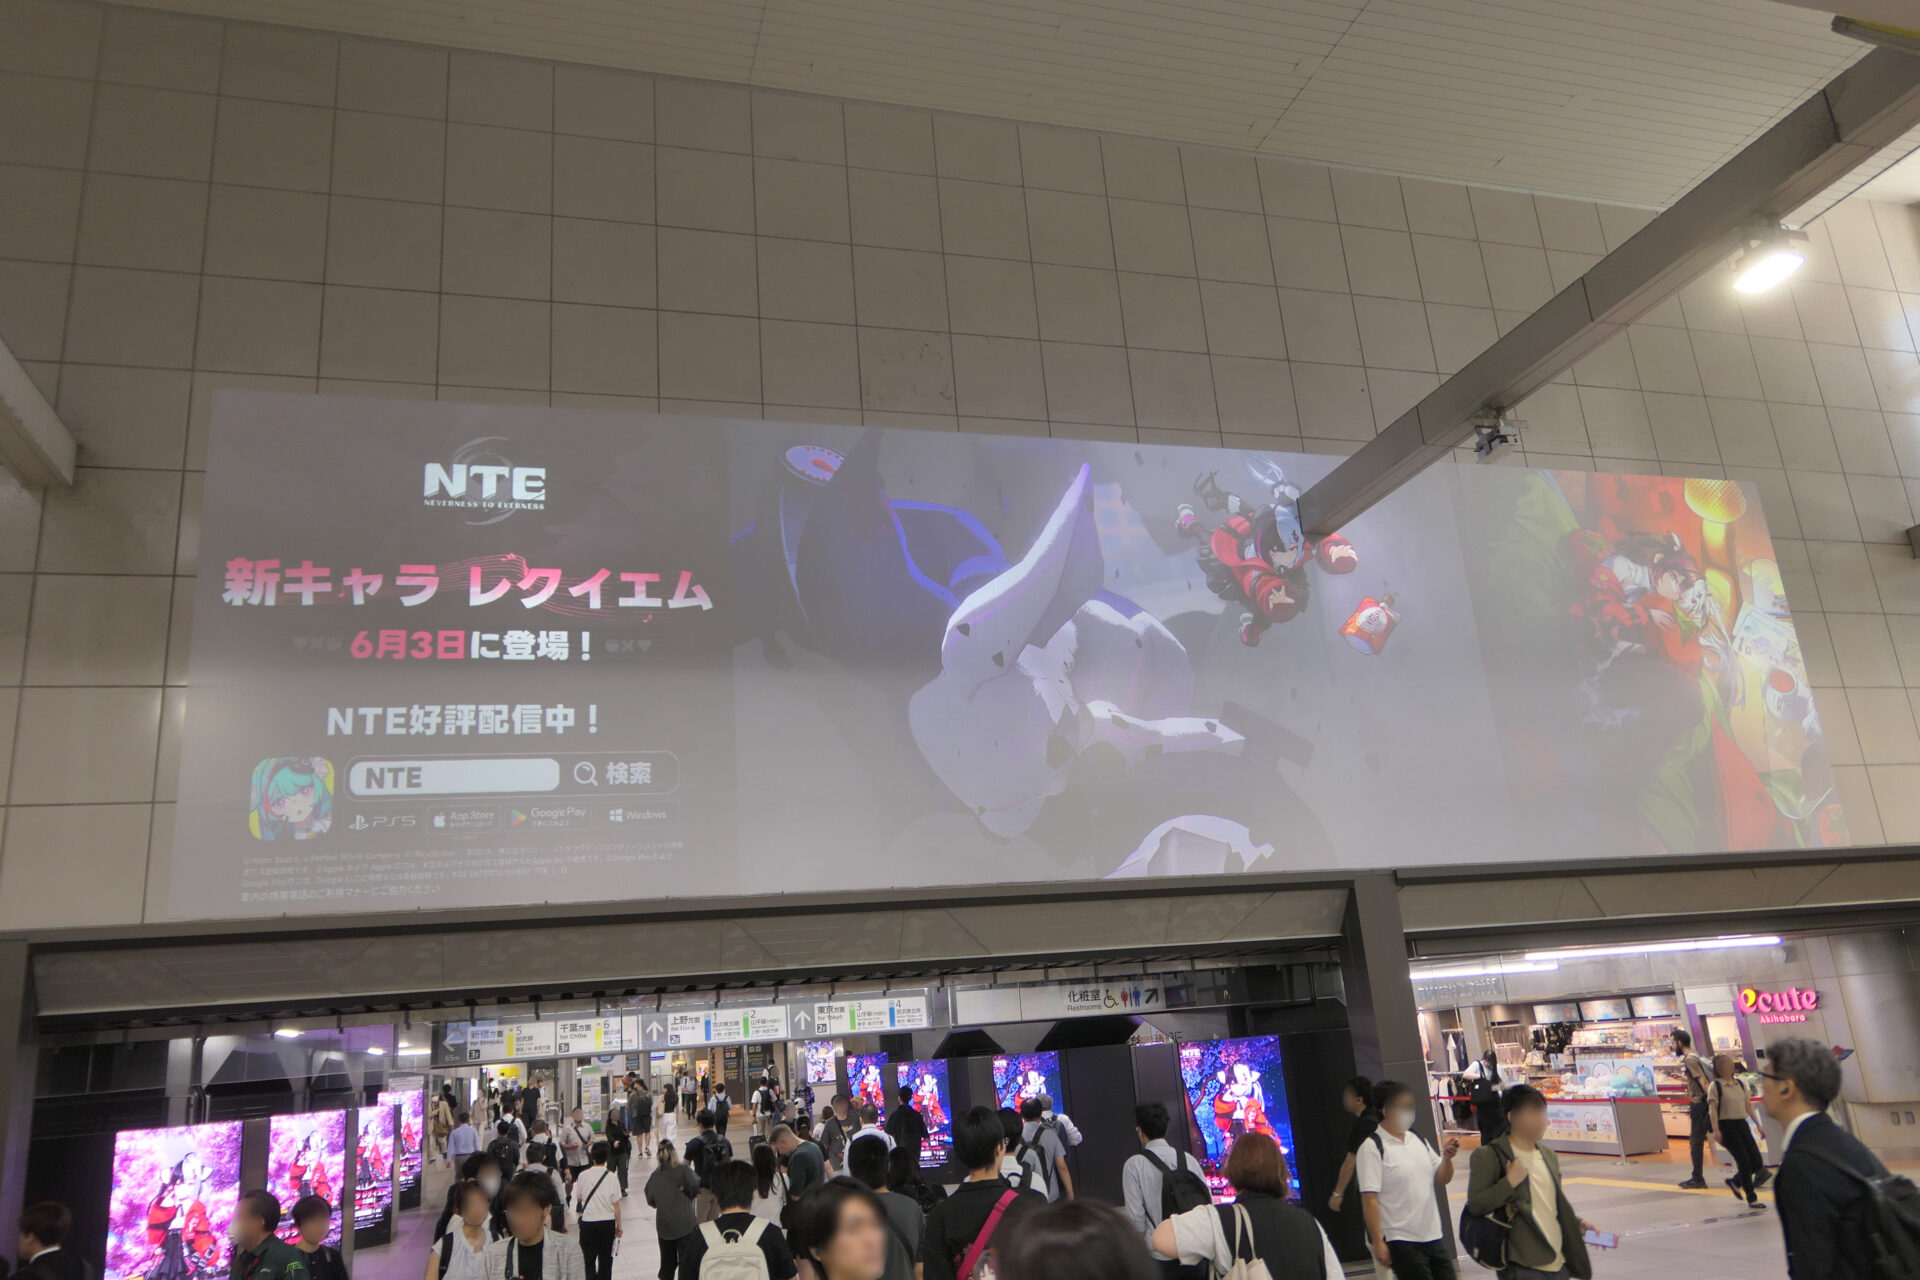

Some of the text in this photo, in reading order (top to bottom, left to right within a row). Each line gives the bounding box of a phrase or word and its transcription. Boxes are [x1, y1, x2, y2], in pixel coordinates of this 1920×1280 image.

[424, 462, 546, 501] NTE
[424, 500, 478, 508] NEVERNESS
[498, 502, 544, 510] EVERNESS
[222, 556, 713, 611] 新キャラ レクイエム
[350, 629, 592, 662] 6月3日に登場！
[327, 704, 598, 737] NTE好評配信中！
[364, 766, 423, 789] NTE
[606, 761, 652, 785] 検索
[450, 810, 496, 820] App Store
[530, 806, 586, 820] Google Play
[626, 810, 667, 820] Windows
[372, 815, 416, 828] PS5
[1068, 990, 1101, 1003] 化粧室
[1738, 986, 1818, 1014] ecute
[857, 1002, 862, 1011] 3
[896, 1000, 902, 1008] 4
[1067, 1004, 1102, 1012] Restrooms
[751, 1009, 757, 1018] 2
[817, 1005, 845, 1015] 東京方面
[671, 1015, 701, 1025] 上野方面
[713, 1012, 717, 1020] 1
[1759, 1013, 1807, 1024] Akihabara
[560, 1023, 592, 1033] 千葉方面
[604, 1019, 610, 1029] 6
[516, 1026, 522, 1036] 5
